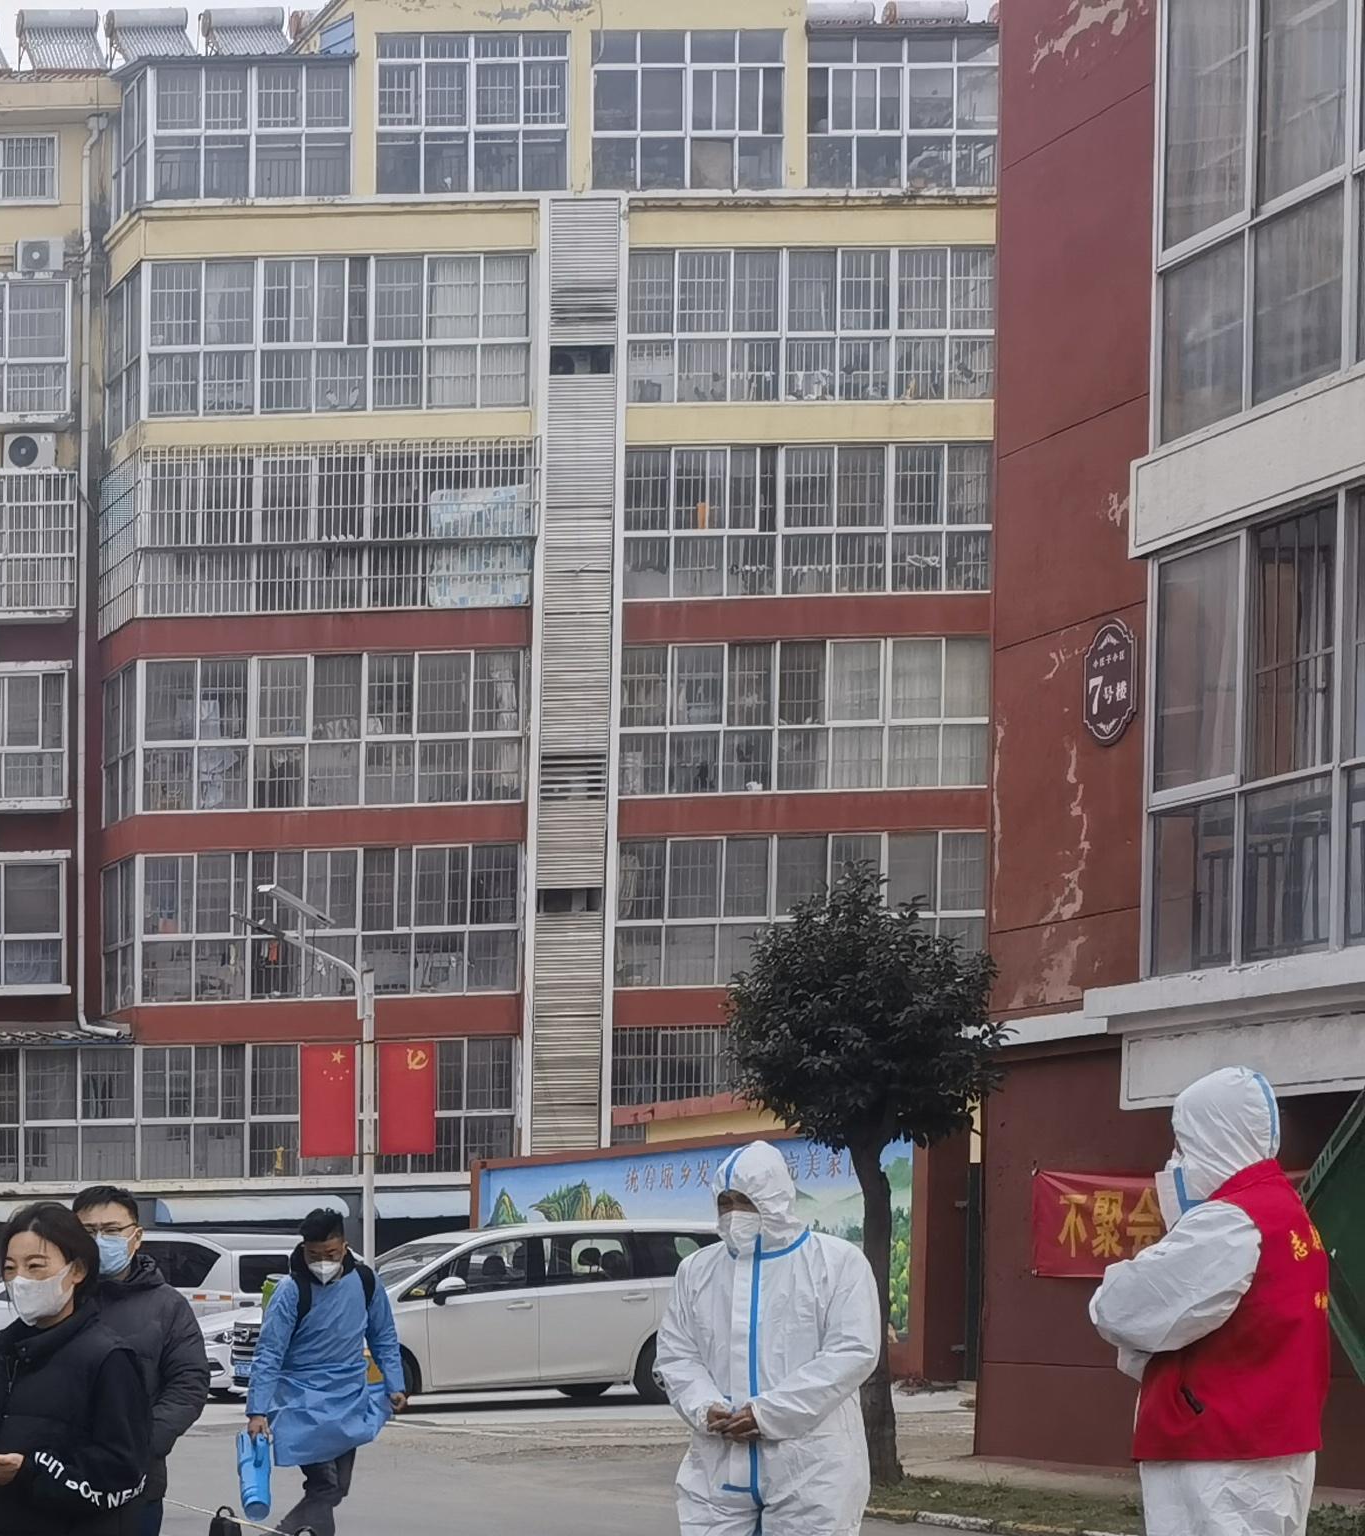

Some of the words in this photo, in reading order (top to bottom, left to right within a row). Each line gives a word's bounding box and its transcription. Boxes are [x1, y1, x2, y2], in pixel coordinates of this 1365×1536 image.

[1089, 676, 1128, 715] 7号楼
[625, 1159, 723, 1193] 统筹城乡发
[1058, 1187, 1161, 1257] 不聚会
